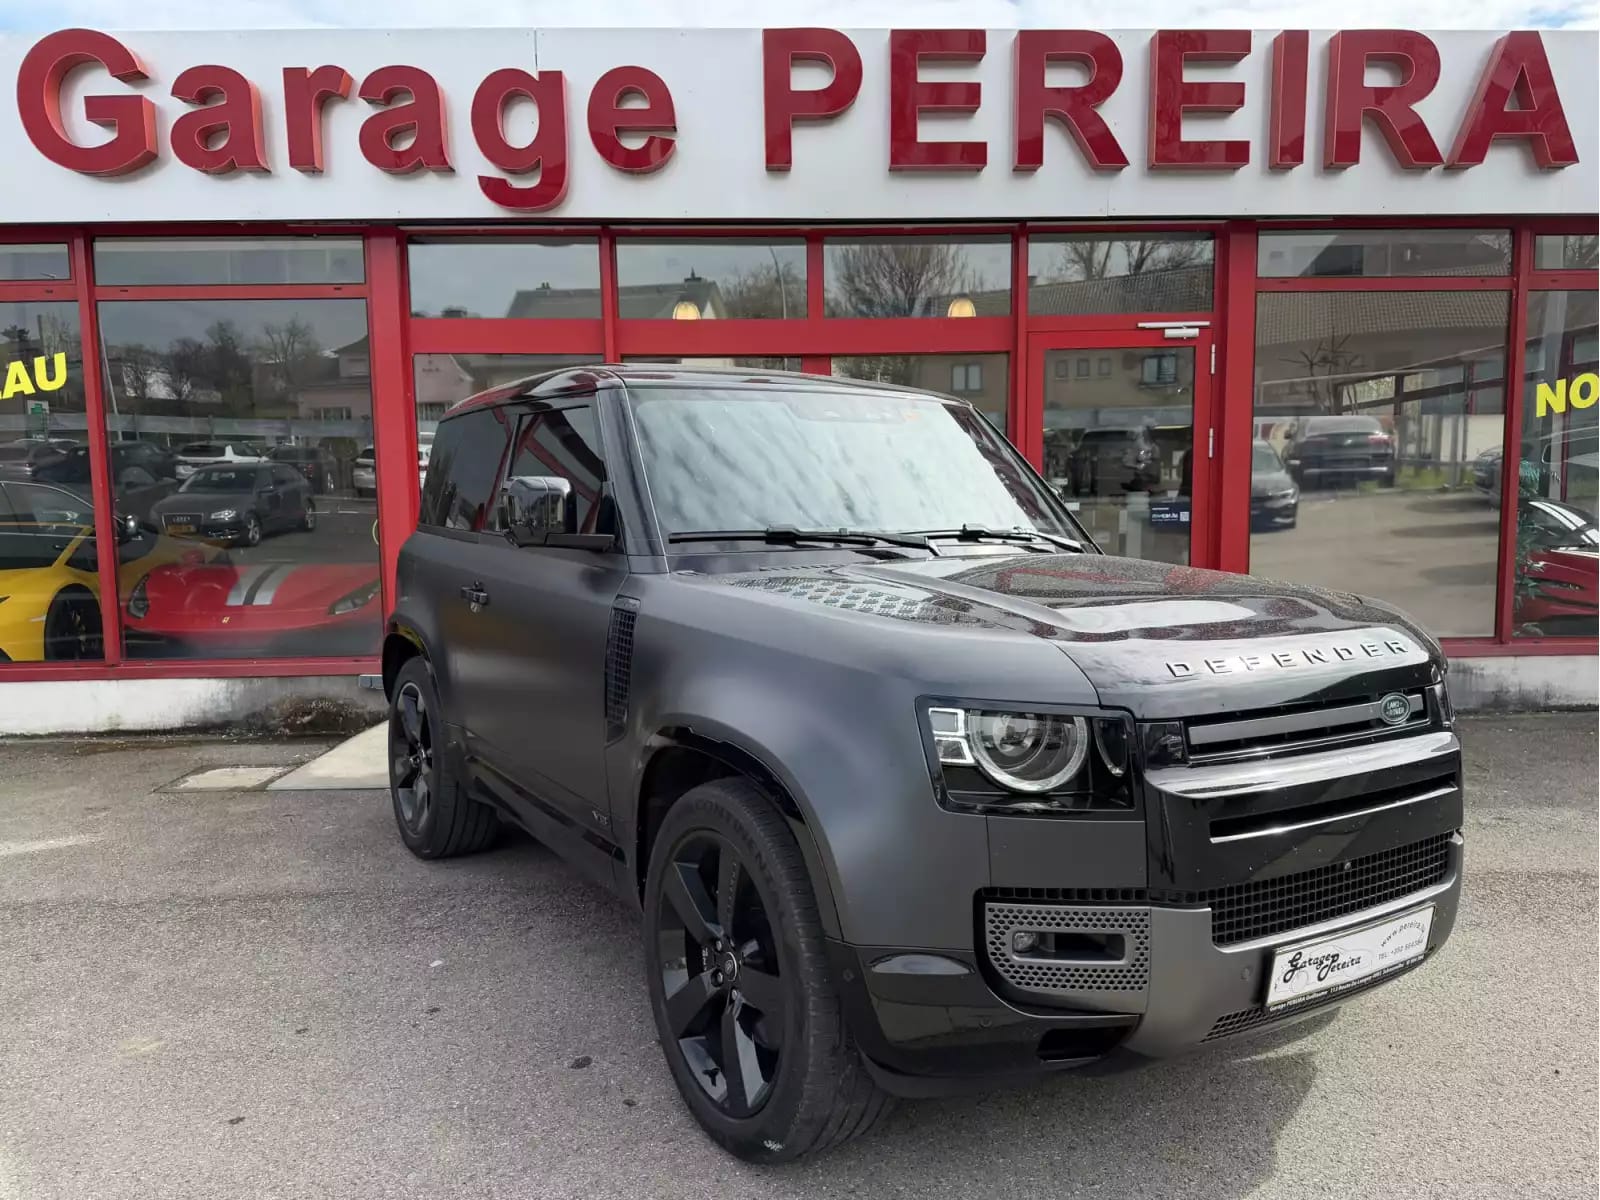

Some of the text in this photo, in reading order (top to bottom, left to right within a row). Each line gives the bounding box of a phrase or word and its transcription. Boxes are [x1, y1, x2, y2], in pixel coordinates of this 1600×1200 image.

[16, 28, 1581, 213] Garage PEREIRA
[0, 351, 68, 400] AU
[1165, 640, 1409, 678] DEFENDER
[1283, 951, 1331, 983] Garage
[1317, 953, 1361, 982] Pereira
